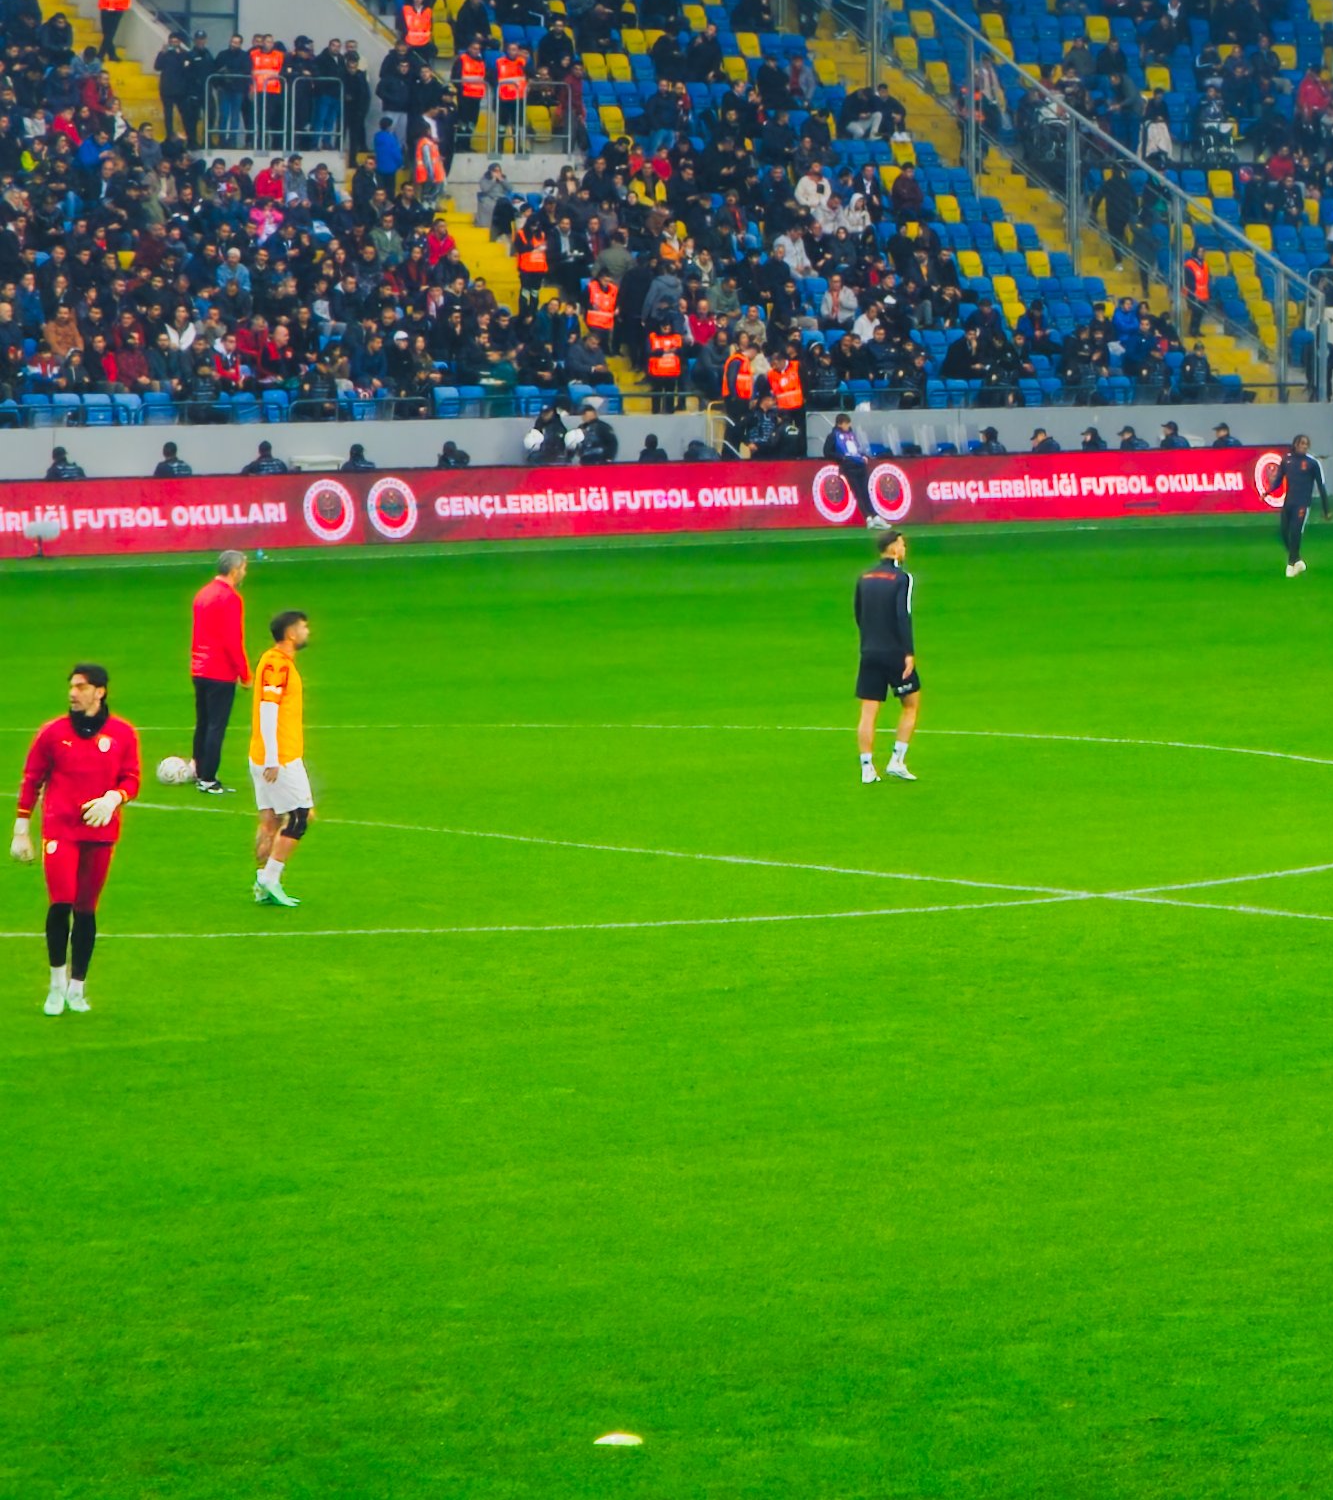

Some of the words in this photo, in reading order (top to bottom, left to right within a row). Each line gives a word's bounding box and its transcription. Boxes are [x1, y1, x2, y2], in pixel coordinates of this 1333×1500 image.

[434, 486, 609, 519] GENÇLERBİRLİĞİ
[612, 488, 695, 511] FUTBOL
[698, 484, 799, 507] OKULLARI
[927, 473, 1078, 503] GENÇLERBİRLİĞİ
[1081, 474, 1153, 497] FUTBOL
[1155, 471, 1244, 494] OKULLARI
[72, 506, 167, 531] FUTBOL
[171, 501, 287, 528] OKULLARI
